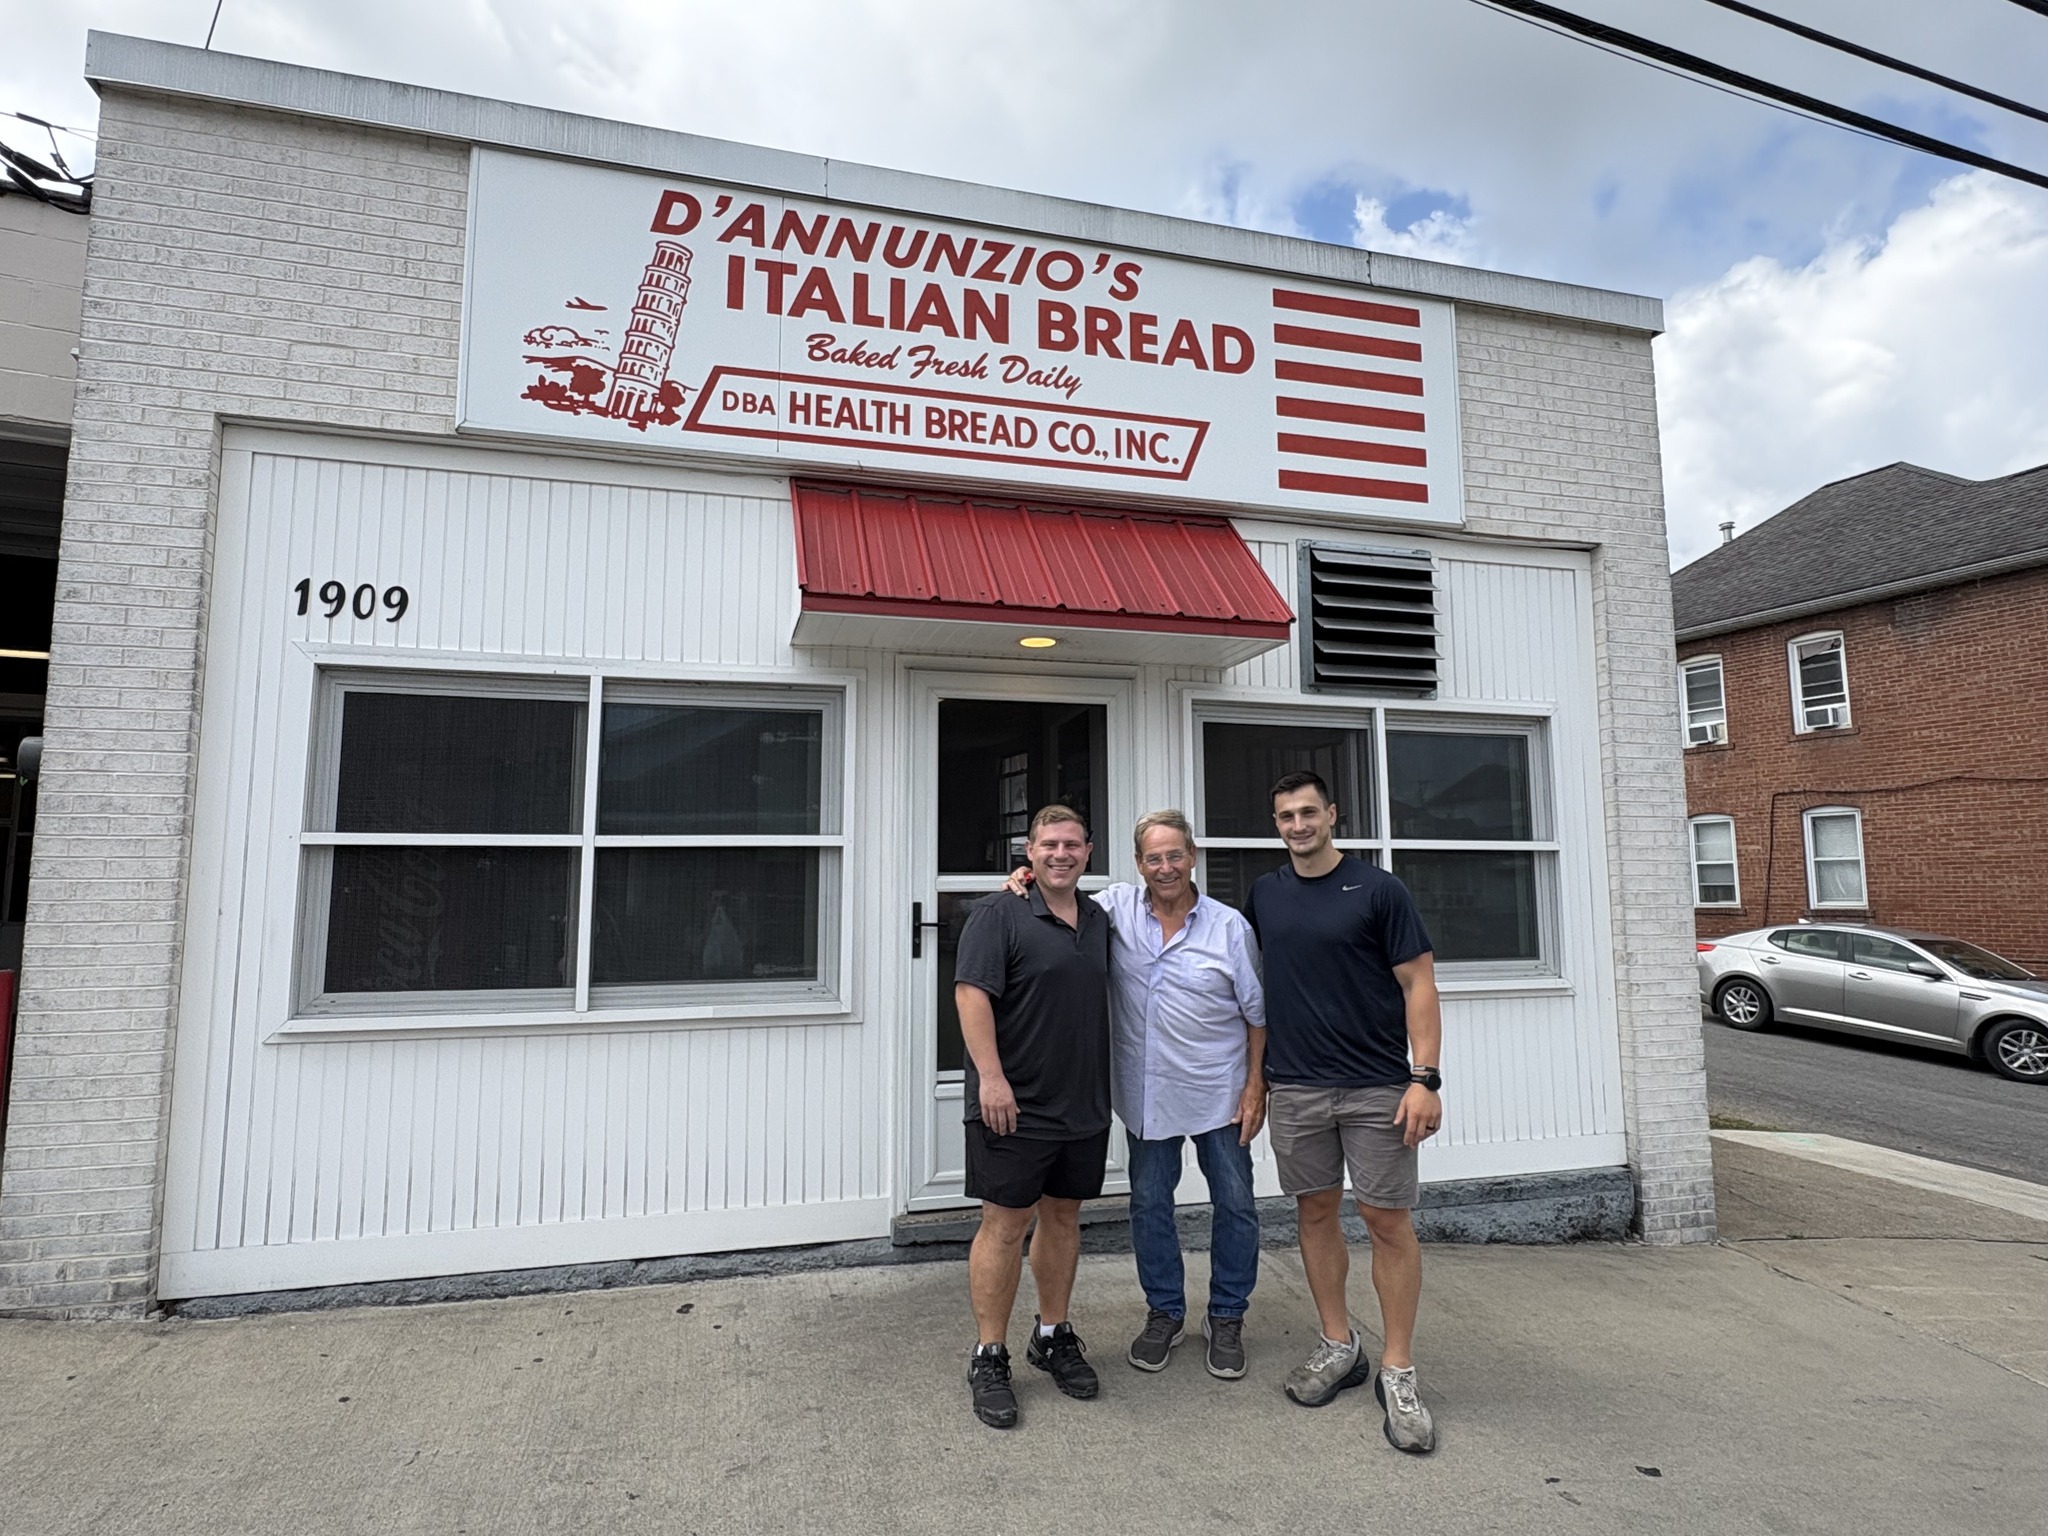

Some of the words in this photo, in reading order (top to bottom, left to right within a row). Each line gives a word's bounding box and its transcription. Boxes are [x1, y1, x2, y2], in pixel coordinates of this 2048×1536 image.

[649, 189, 1143, 302] D'ANNUNZIO'S
[726, 254, 1010, 344] ITALIAN
[1038, 298, 1256, 375] BREAD
[805, 332, 902, 371] Baked
[907, 344, 989, 379] Fresh
[999, 354, 1083, 400] Daily
[722, 389, 776, 416] DBA
[789, 390, 911, 436] HEALTH
[925, 405, 1038, 449] BREAD
[294, 577, 409, 623] 1909
